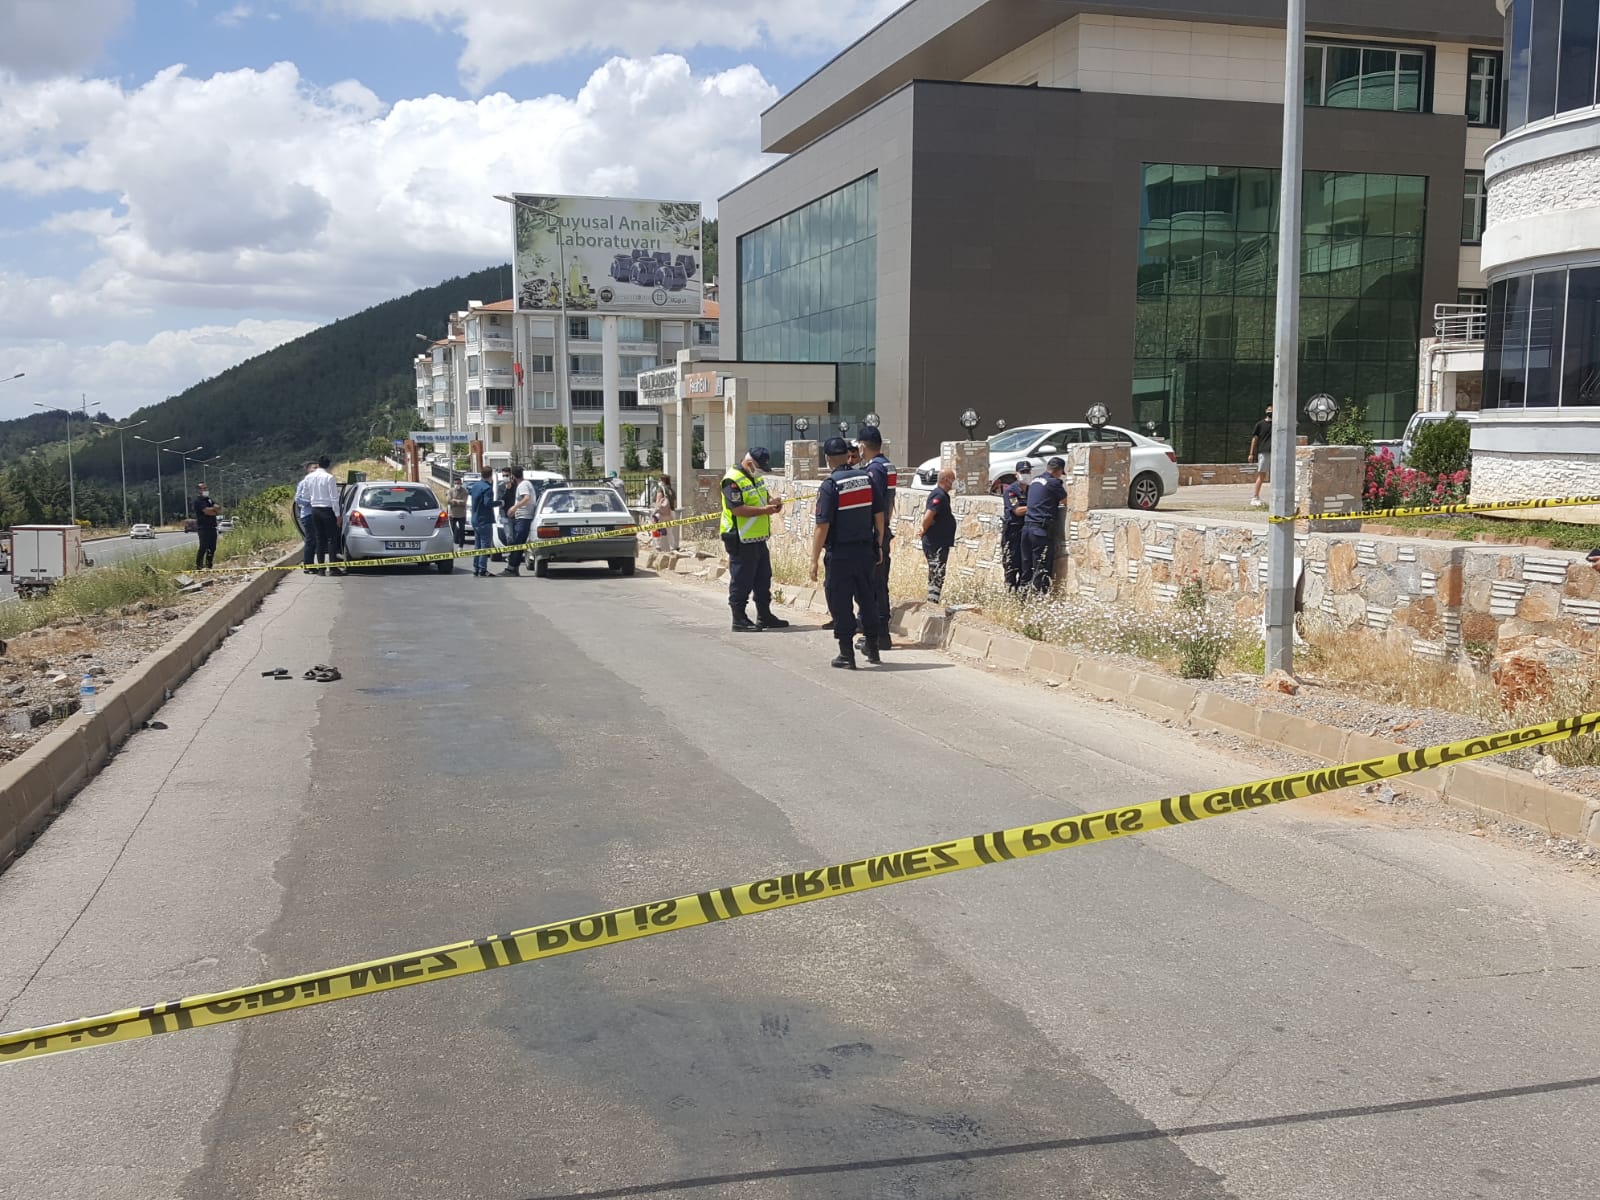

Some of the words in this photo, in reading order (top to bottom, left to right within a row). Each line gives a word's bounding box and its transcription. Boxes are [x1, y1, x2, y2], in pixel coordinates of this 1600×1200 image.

[546, 214, 613, 232] Duyusal
[618, 216, 670, 232] Analiz
[555, 231, 661, 250] Laboratuvarı
